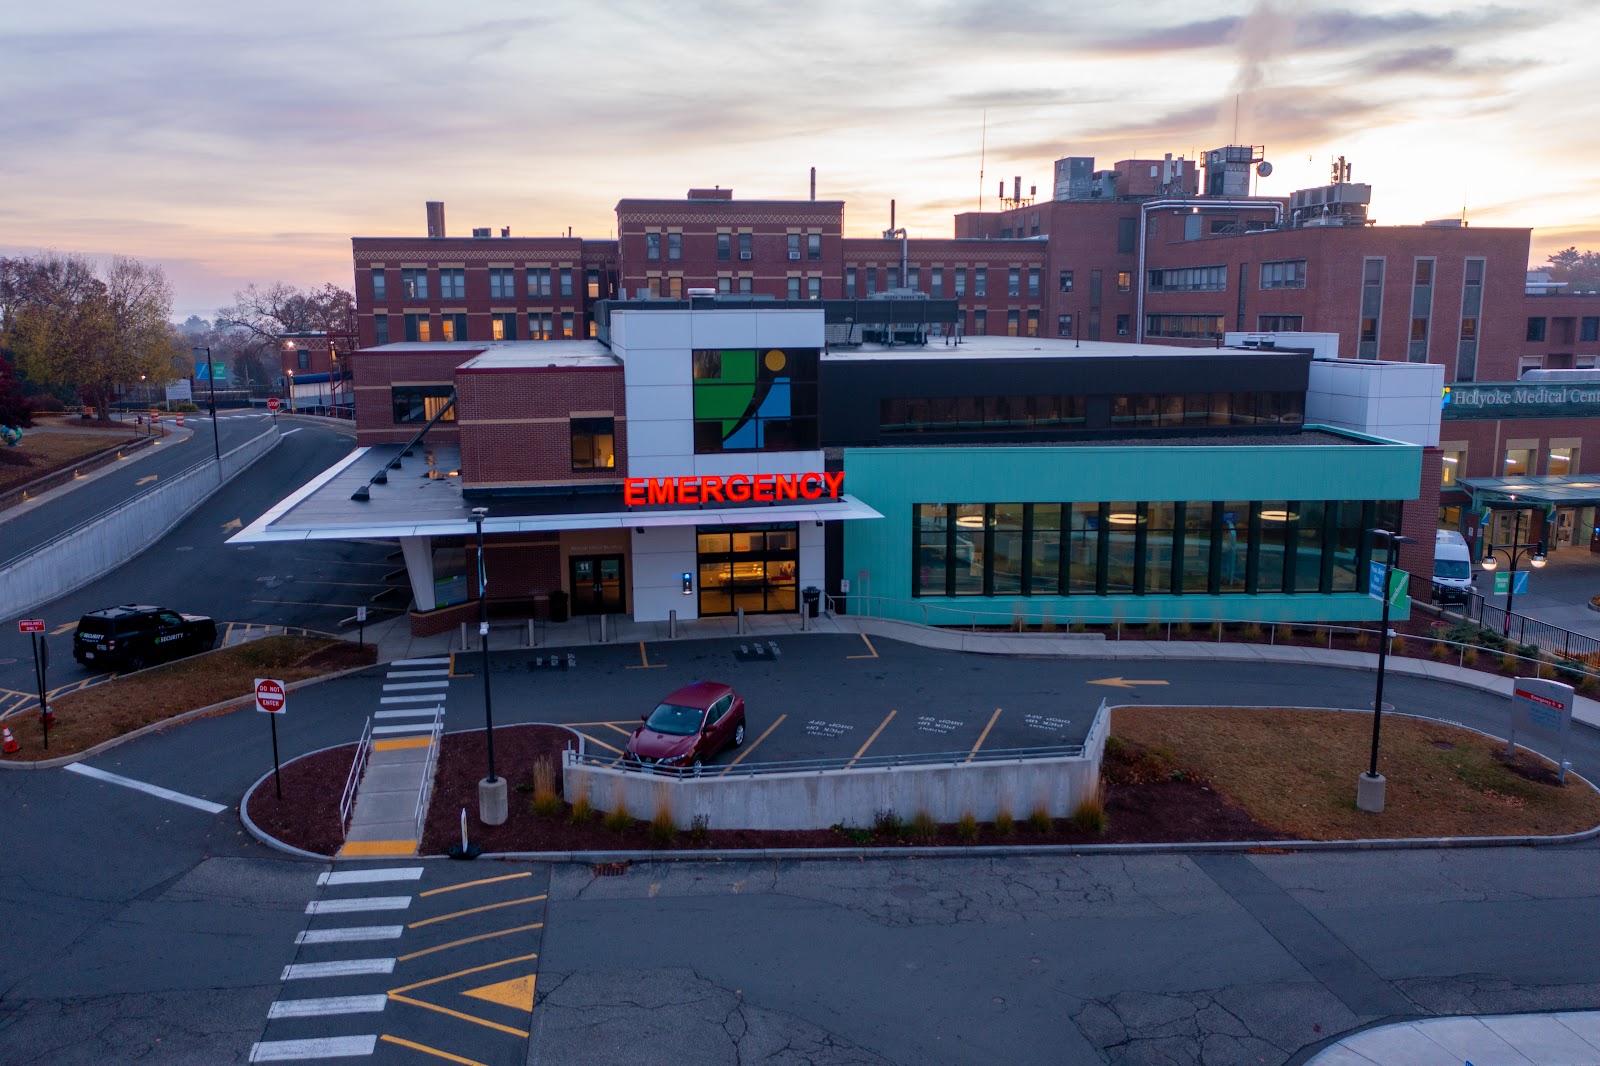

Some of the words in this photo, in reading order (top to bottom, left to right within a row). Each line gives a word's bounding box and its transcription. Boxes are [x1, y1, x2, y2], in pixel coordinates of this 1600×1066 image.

[1453, 389, 1511, 408] Holyoke
[1514, 388, 1567, 404] Medical
[624, 471, 846, 505] EMERGENCY
[580, 562, 589, 570] 11
[83, 632, 105, 640] SECURITY
[160, 632, 184, 643] SECURITY
[828, 722, 854, 730] DROP
